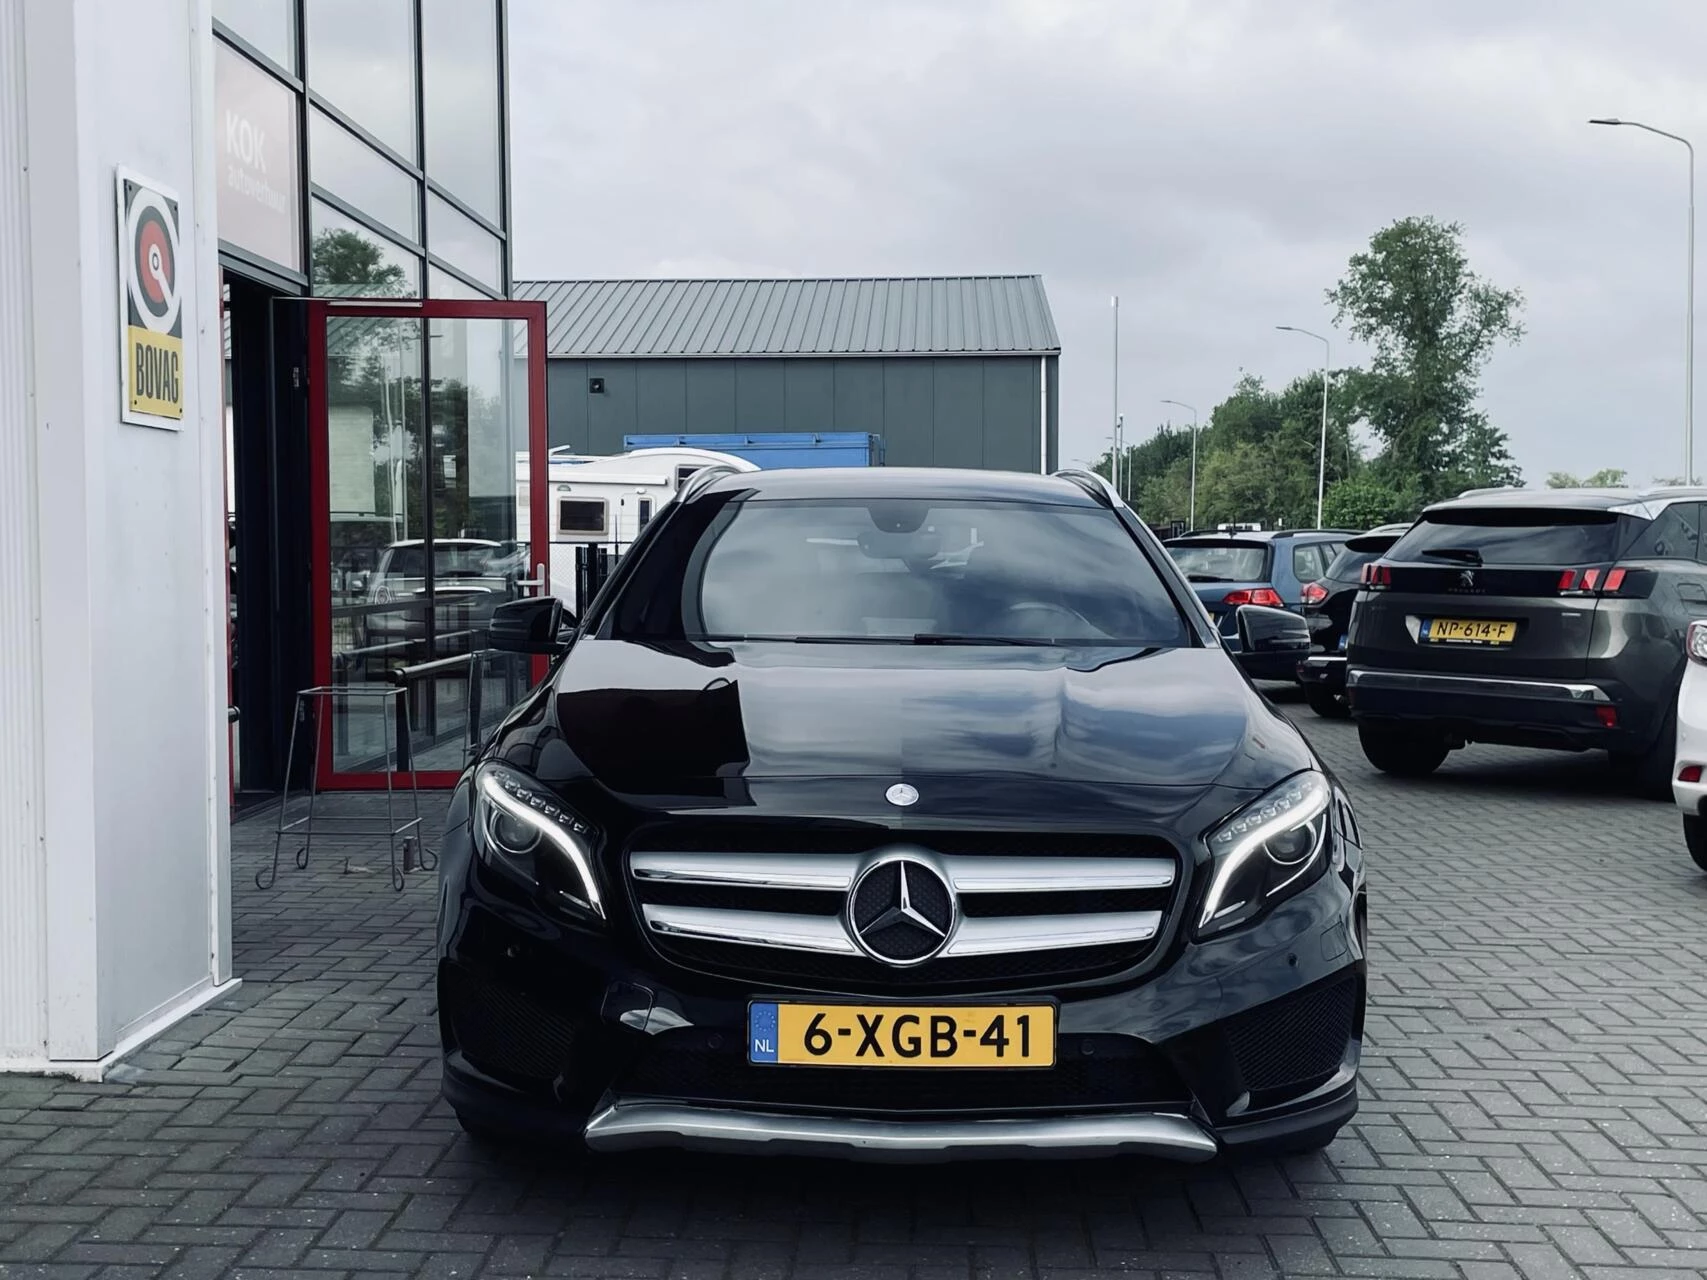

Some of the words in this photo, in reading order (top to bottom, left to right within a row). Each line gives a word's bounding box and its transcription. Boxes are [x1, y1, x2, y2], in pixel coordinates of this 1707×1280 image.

[225, 108, 267, 174] KOK
[135, 342, 179, 404] BOVAG
[1437, 621, 1509, 638] NP-614-F
[754, 1039, 774, 1053] NL
[804, 1012, 1030, 1058] 6-XGB-41
